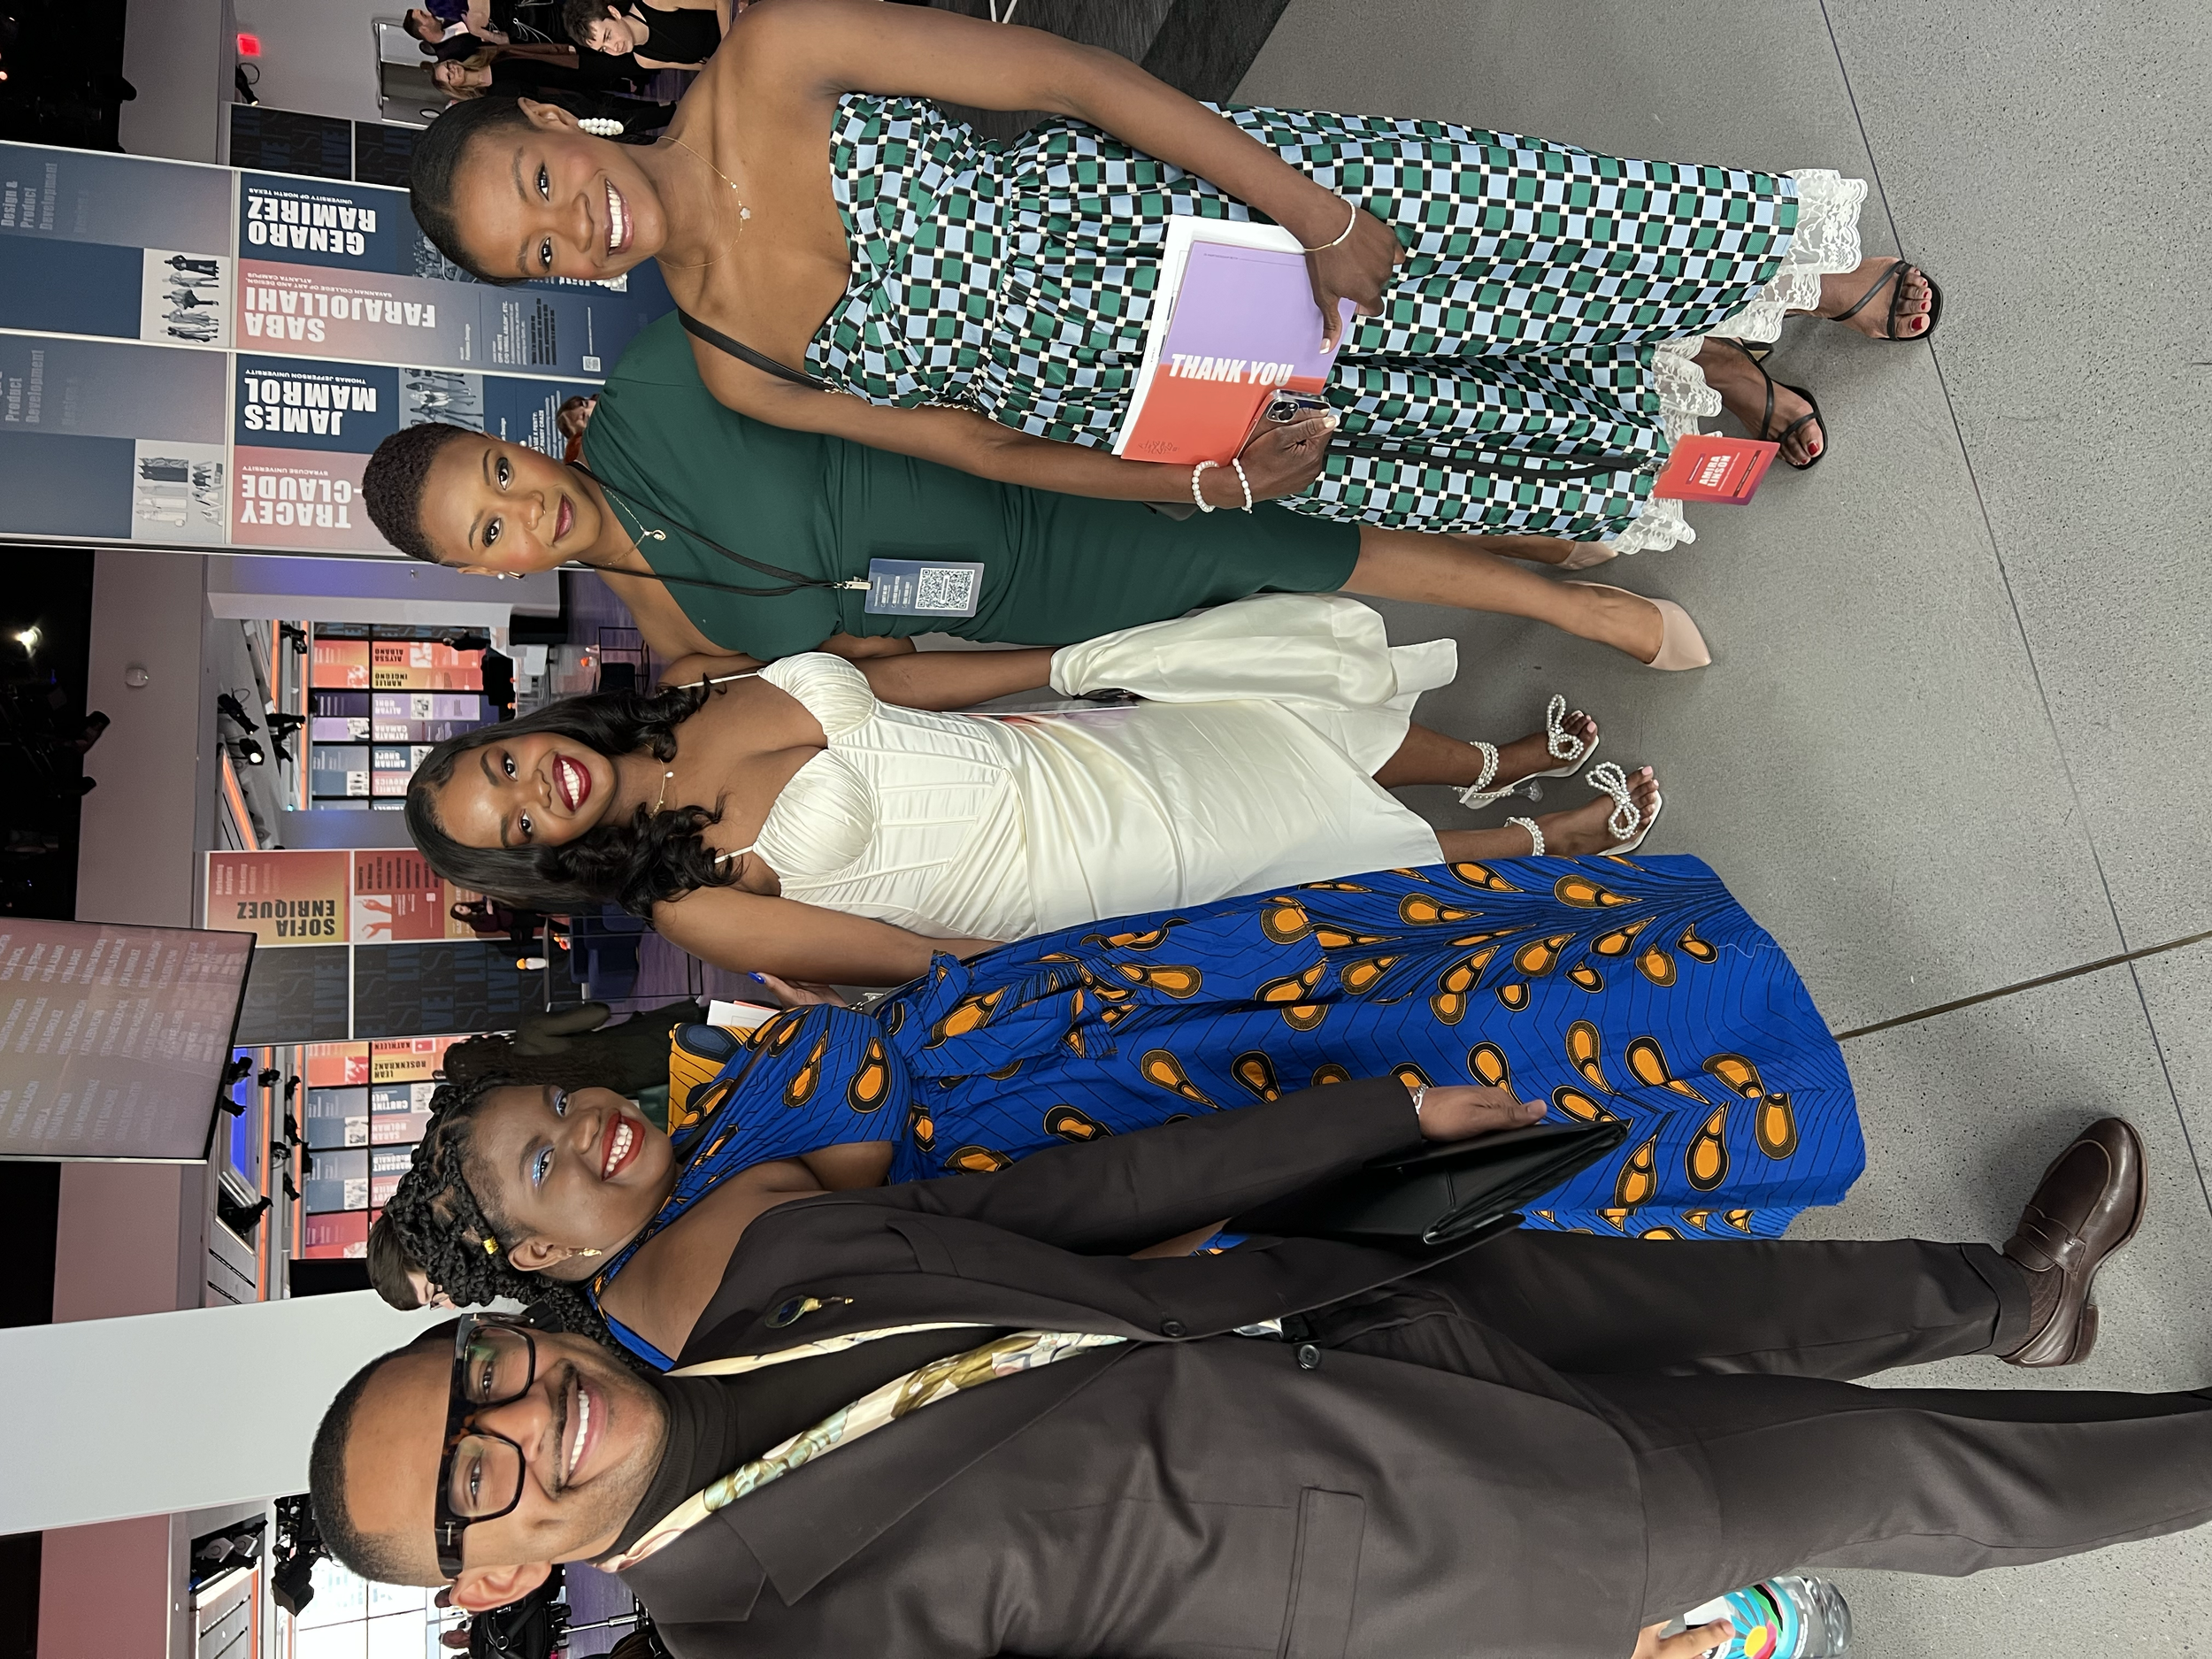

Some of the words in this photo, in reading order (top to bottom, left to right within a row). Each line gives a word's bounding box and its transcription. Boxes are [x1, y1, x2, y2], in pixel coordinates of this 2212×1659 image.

[39, 162, 58, 230] Development
[248, 187, 273, 196] TEXAS
[273, 190, 300, 199] NORTH
[310, 195, 353, 204] UNIVERSITY
[1, 190, 19, 227] Design
[19, 188, 36, 228] Product
[247, 196, 376, 233] RAMIREZ
[248, 220, 365, 256] GENARO
[245, 277, 275, 287] DESIGN,
[247, 272, 279, 280] CAMPUS
[279, 275, 312, 284] ATLANTA
[319, 285, 353, 294] COLLEGE
[354, 288, 392, 298] SAVANNAH
[246, 286, 436, 328] FARAJOLLAHI
[244, 311, 326, 342] SABA
[245, 369, 290, 378] UNIVERSITY
[290, 372, 334, 382] JEFFERSON
[334, 376, 366, 385] THOMAS
[1169, 353, 1248, 384] THANK
[1248, 360, 1294, 388] YOU
[25, 349, 45, 423] Development
[244, 377, 377, 412] MAMROL
[4, 377, 23, 421] Product
[244, 403, 343, 436] JAMES
[288, 468, 328, 477] SYRACUSE
[1698, 456, 1722, 485] AMIRA
[1707, 455, 1732, 488] LINSON
[240, 499, 351, 529] TRACEY
[215, 864, 225, 895] Marketing
[236, 899, 335, 919] ENRIQUEZ
[275, 918, 335, 937] SOFIA
[156, 964, 174, 989] KATHLEEN
[6, 998, 27, 1021] BROOKS
[42, 1009, 65, 1036] ENRIQUEZ
[77, 1026, 99, 1056] KATHLEEN
[88, 1010, 105, 1026] FLYNN
[34, 1036, 53, 1054] SOFIA
[98, 1026, 120, 1057] STEPHANIE
[374, 1041, 411, 1050] KATHLEEN
[374, 1060, 426, 1071] ROSENKRANZ
[374, 1070, 394, 1079] LEAH
